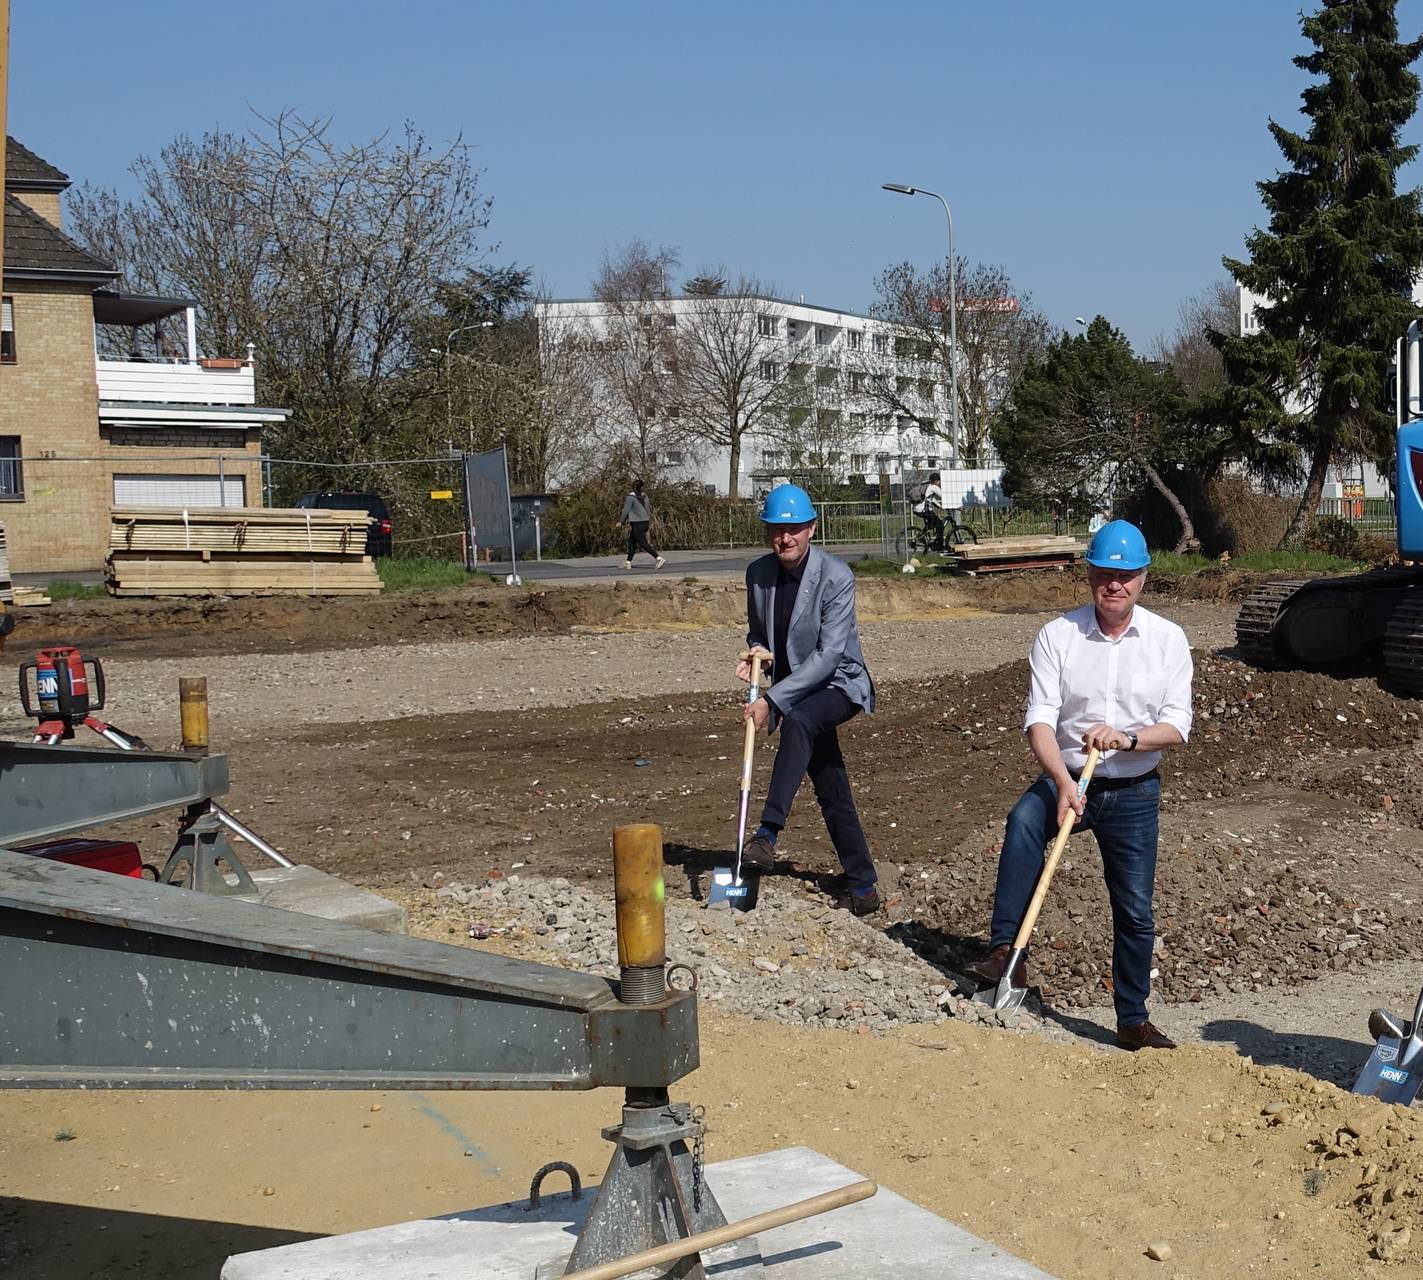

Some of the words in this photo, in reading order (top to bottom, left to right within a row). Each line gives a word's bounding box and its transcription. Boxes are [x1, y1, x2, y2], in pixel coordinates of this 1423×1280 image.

[38, 677, 58, 694] ENN
[726, 887, 743, 897] HENN
[1380, 1068, 1402, 1082] HENN
